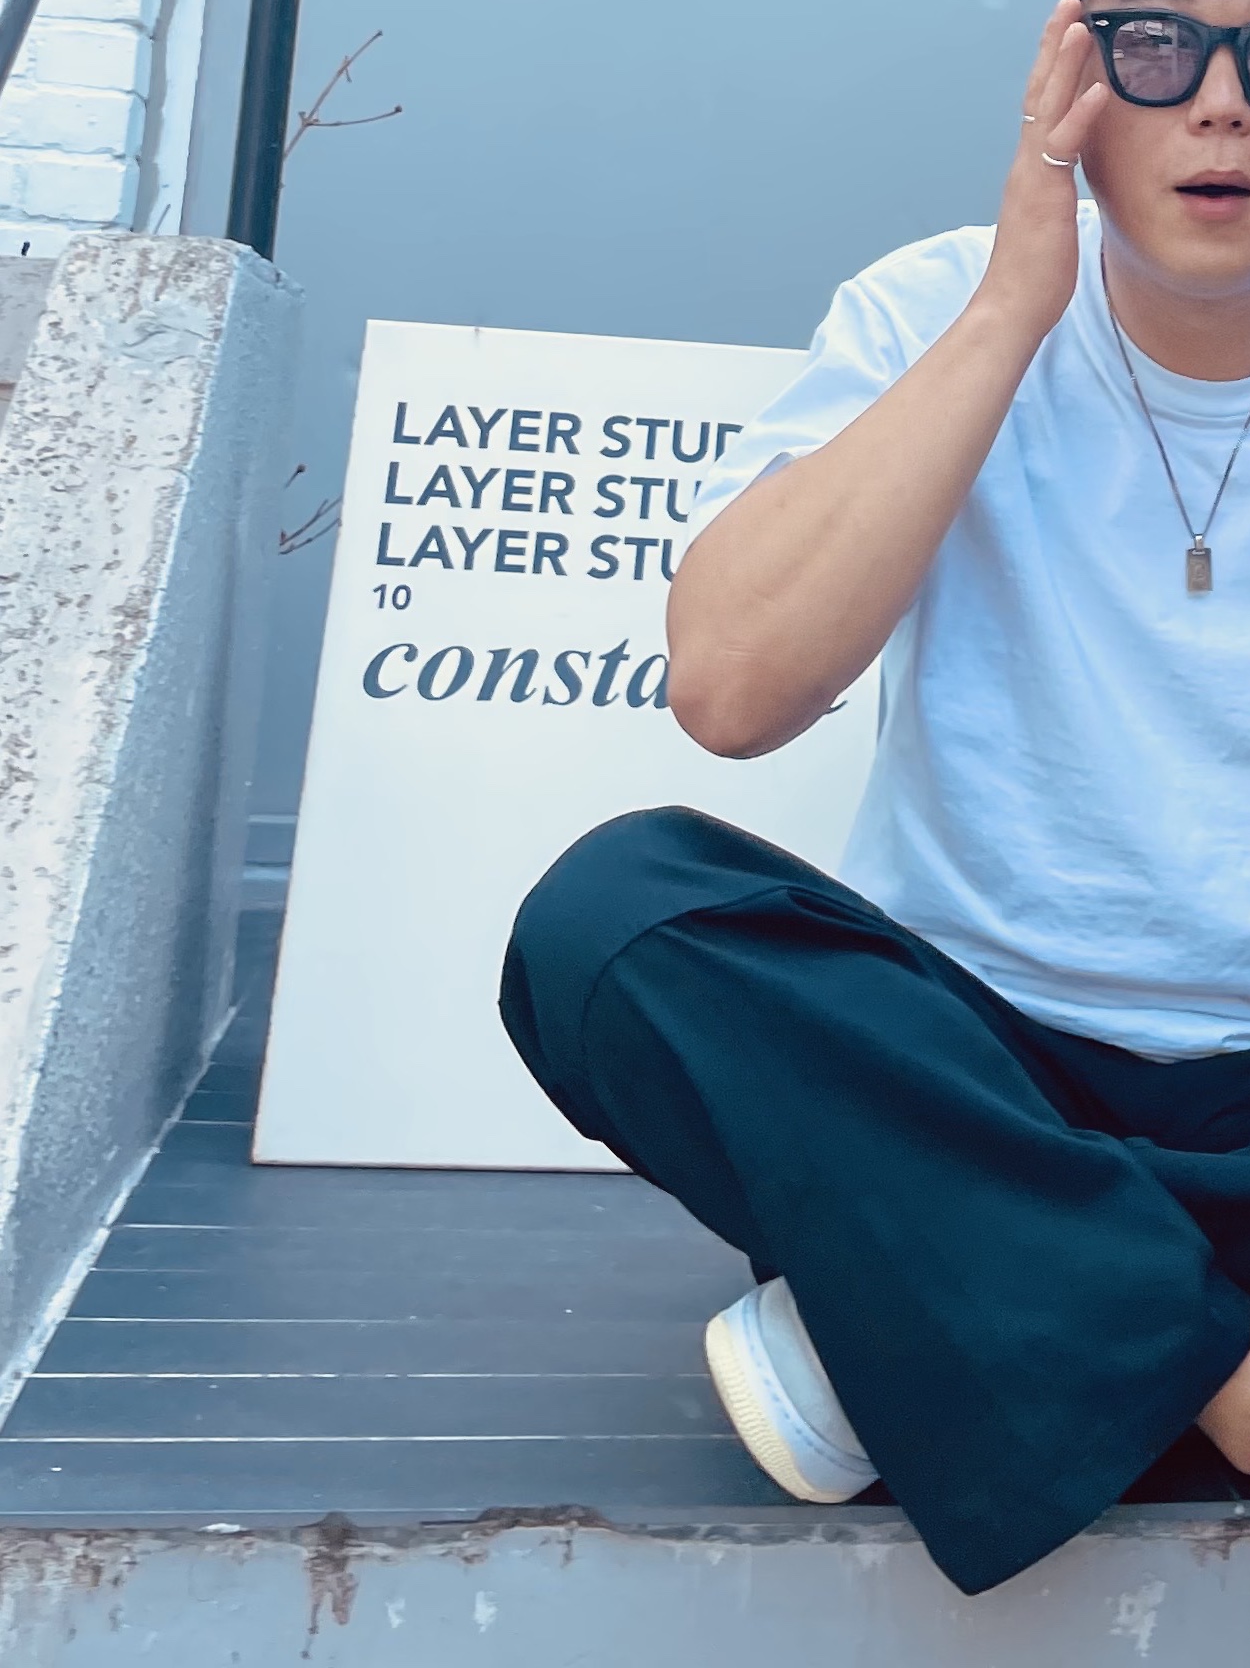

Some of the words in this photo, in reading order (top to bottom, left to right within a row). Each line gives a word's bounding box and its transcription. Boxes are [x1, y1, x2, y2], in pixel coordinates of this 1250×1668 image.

[392, 401, 581, 455] LAYER
[384, 461, 576, 516] LAYER
[375, 522, 569, 577] LAYER
[372, 583, 412, 611] 10
